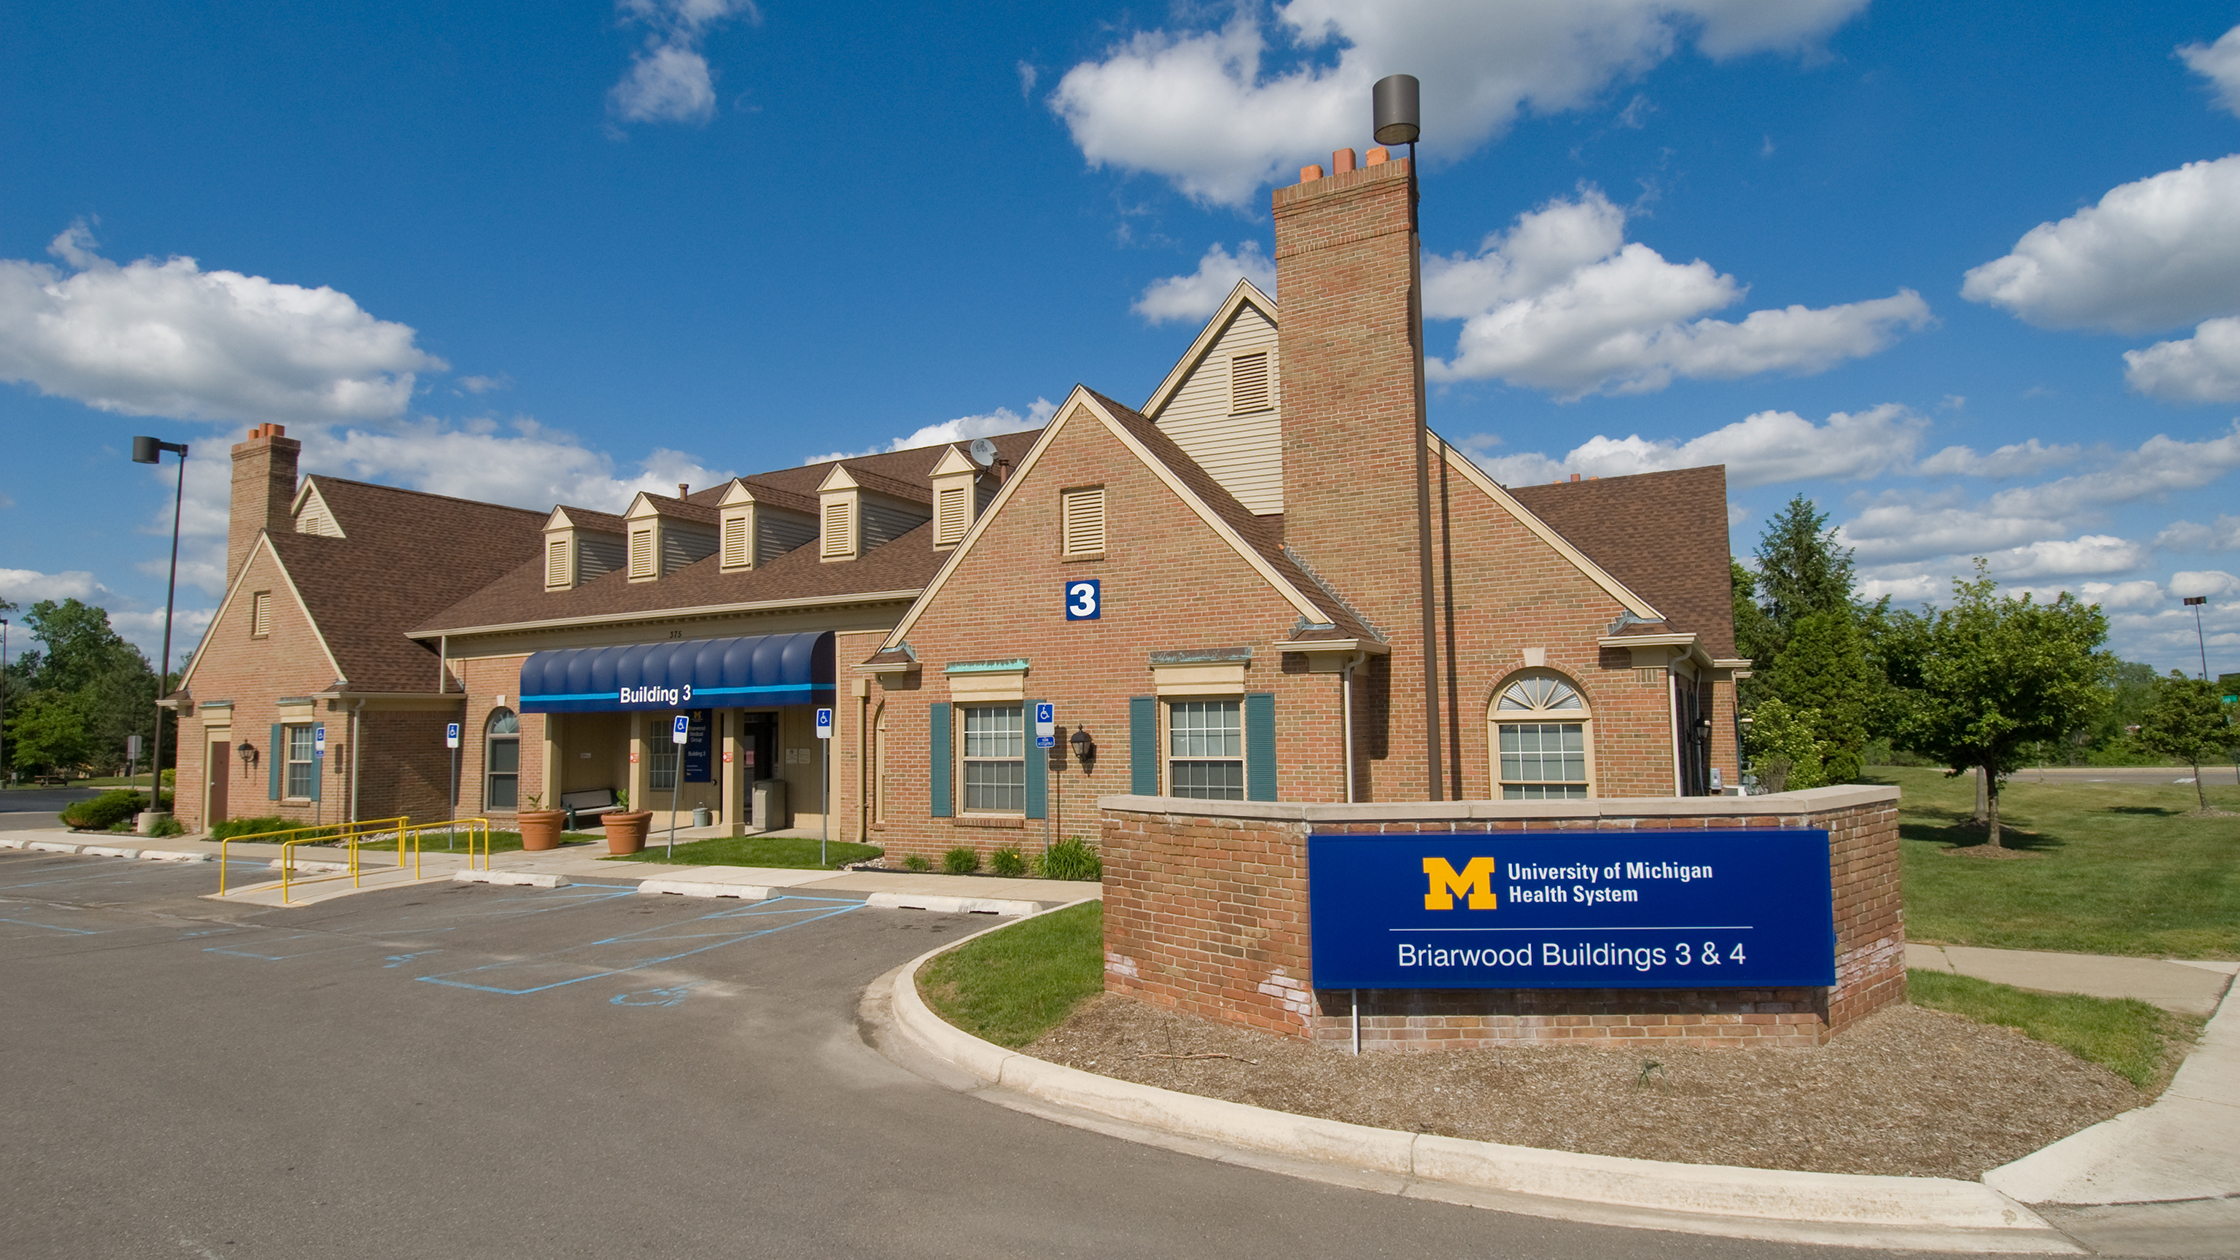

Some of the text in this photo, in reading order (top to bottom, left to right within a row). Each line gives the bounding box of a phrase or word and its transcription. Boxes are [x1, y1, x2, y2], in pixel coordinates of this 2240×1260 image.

[1070, 583, 1096, 617] 3
[669, 630, 682, 639] 375
[620, 684, 691, 706] Building 3
[693, 710, 702, 719] M
[1422, 856, 1497, 910] M
[1508, 861, 1713, 883] University of Michigan
[1509, 885, 1638, 906] Health System
[1398, 941, 1746, 972] Briarwood Buildings 3 & 4
